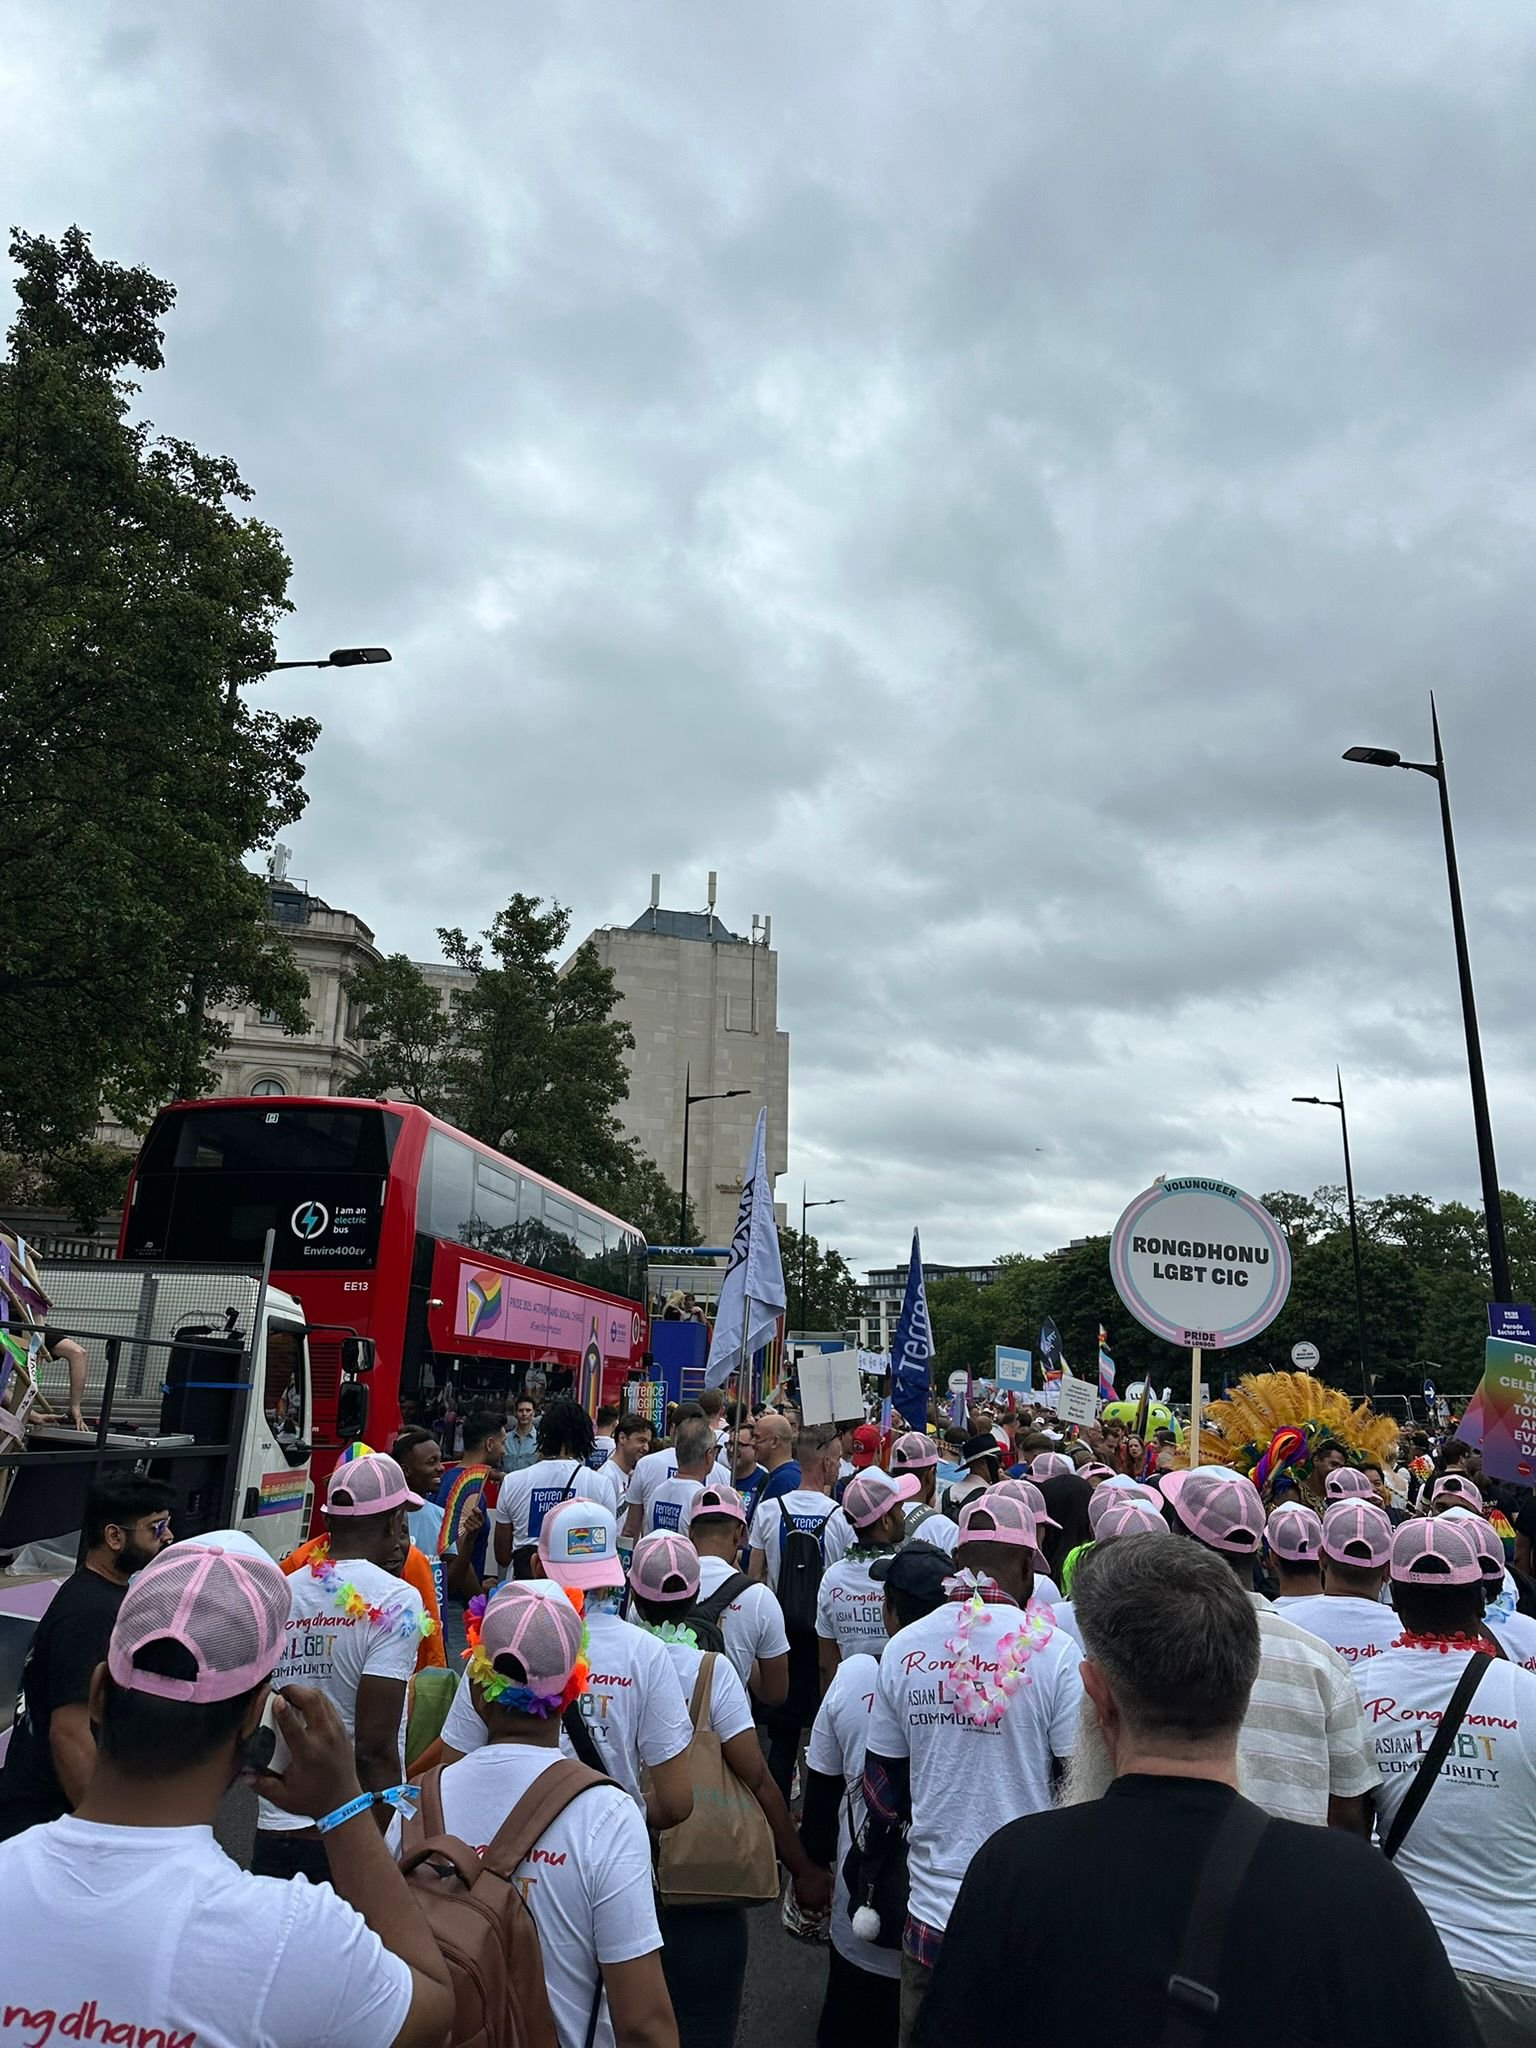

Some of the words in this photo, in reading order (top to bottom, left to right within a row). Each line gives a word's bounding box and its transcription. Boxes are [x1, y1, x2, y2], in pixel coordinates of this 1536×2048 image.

[1164, 1180, 1238, 1199] VOLUNQUEER
[335, 1206, 339, 1214] I
[334, 1216, 367, 1224] electric
[333, 1225, 349, 1233] bus
[303, 1246, 366, 1255] Enviro400EV
[1133, 1236, 1269, 1264] RONGDHONU
[1153, 1262, 1207, 1283] LGBT
[1211, 1269, 1249, 1287] CIC
[344, 1281, 369, 1291] EE13
[1184, 1330, 1216, 1342] PRIDE
[622, 1386, 664, 1397] Terrence
[533, 1491, 574, 1502] Terrene
[285, 1611, 356, 1633] ongdhanu
[291, 1634, 337, 1659] LGBT
[908, 1689, 936, 1706] ASIAN
[1375, 1737, 1413, 1754] ASIAN
[1416, 1729, 1497, 1761] LBT
